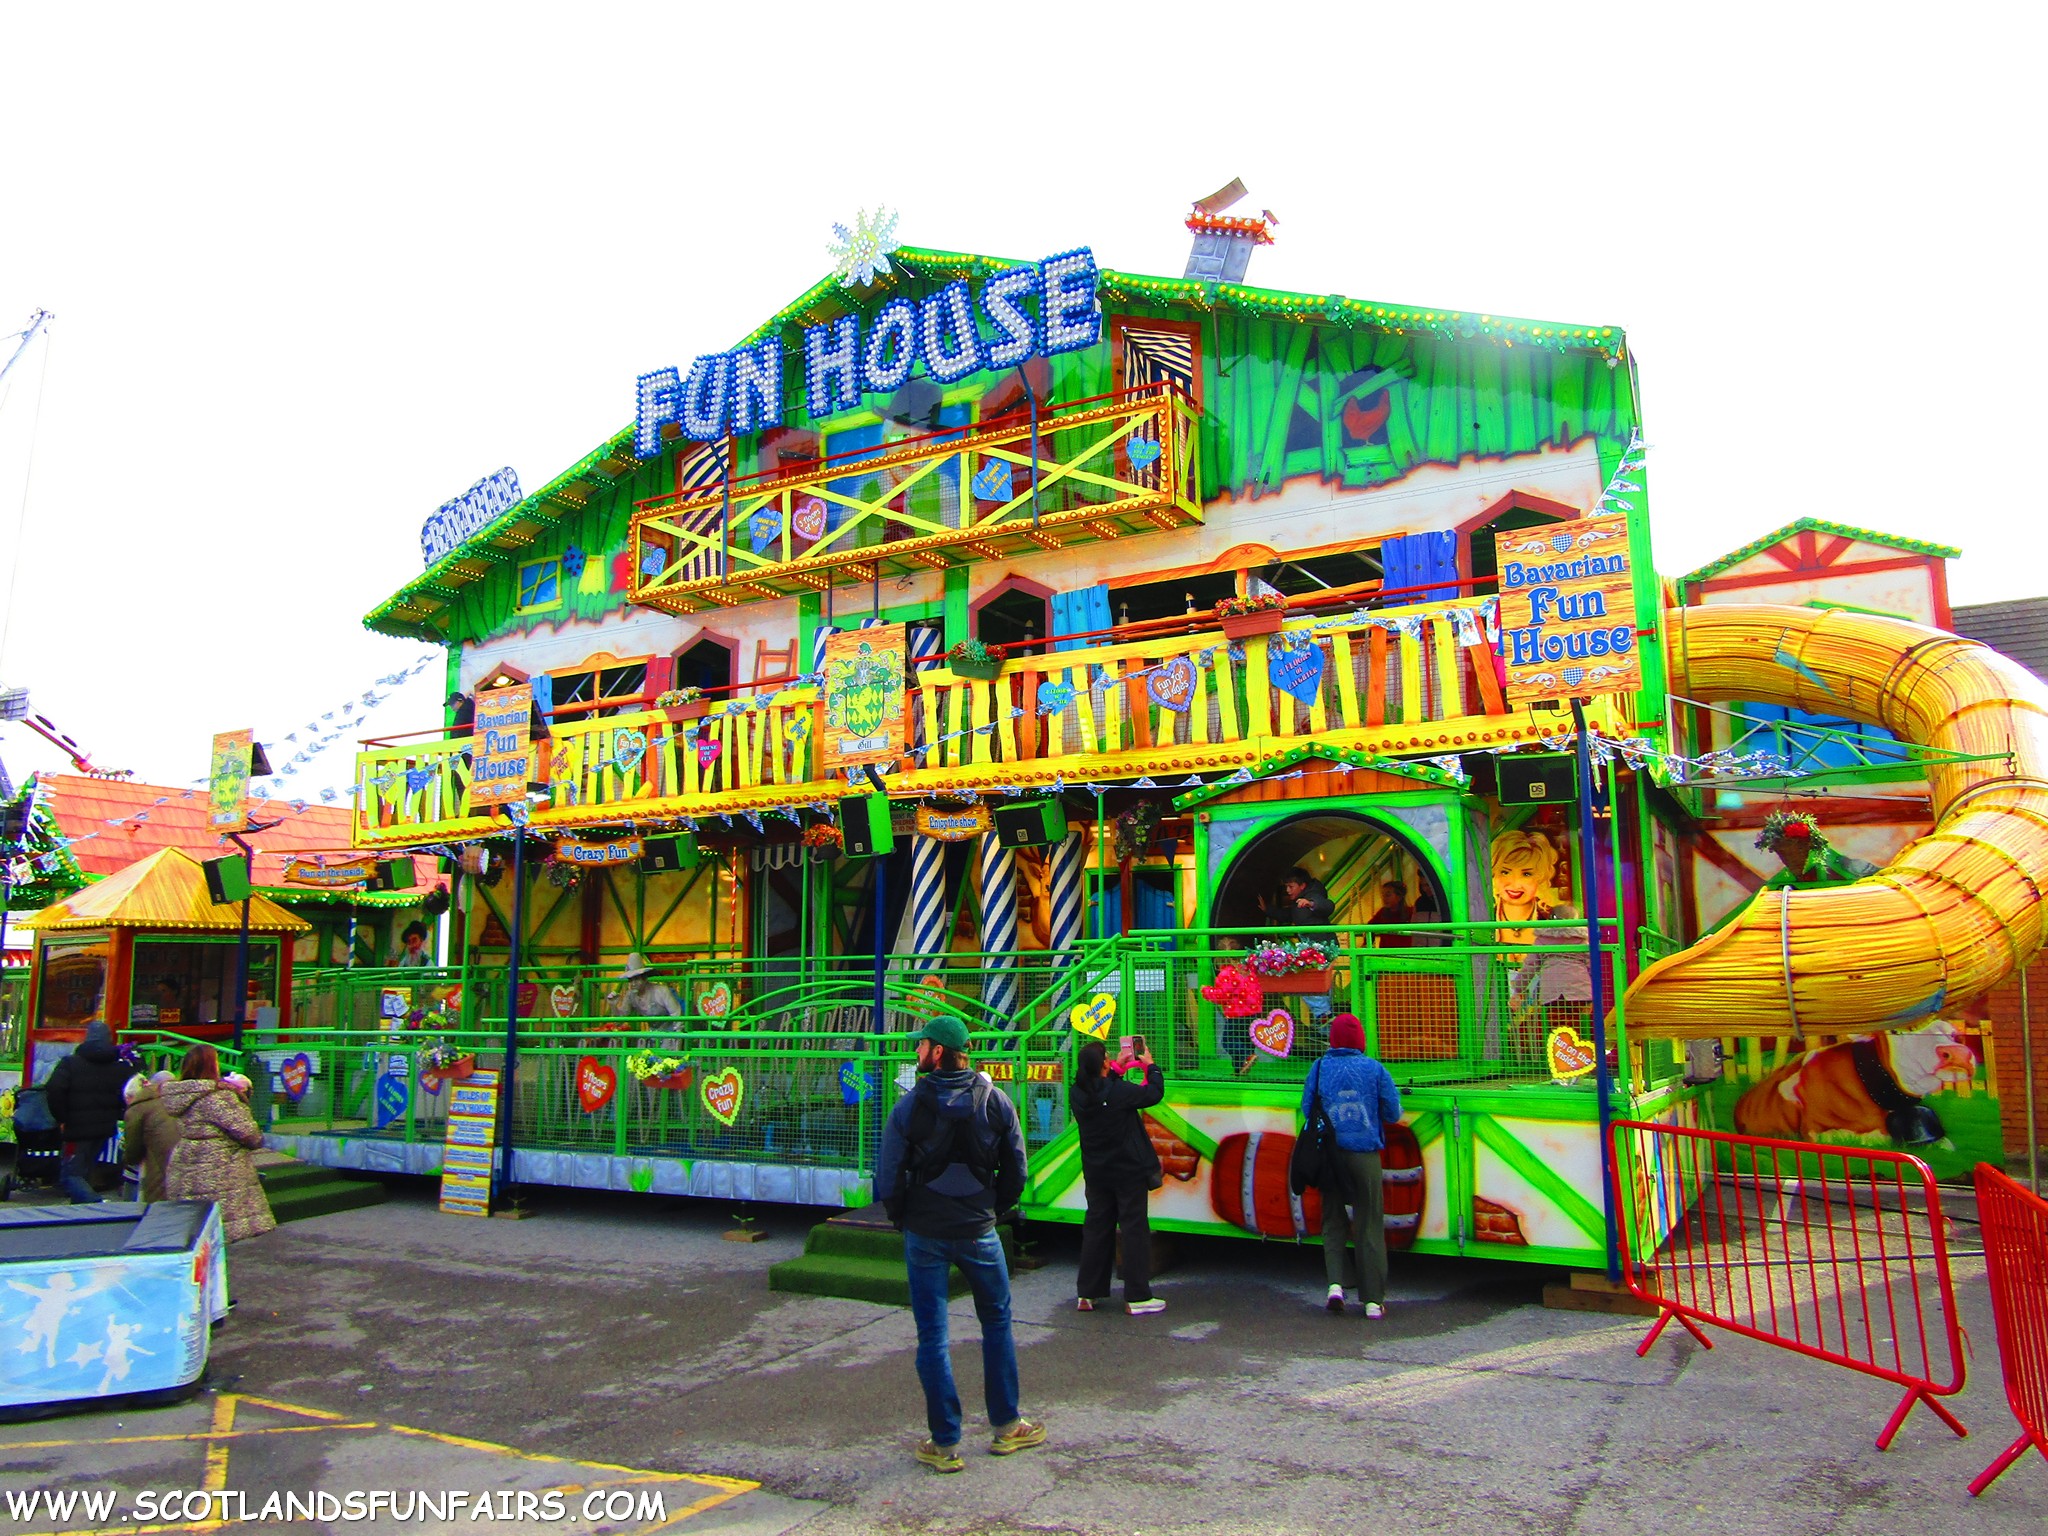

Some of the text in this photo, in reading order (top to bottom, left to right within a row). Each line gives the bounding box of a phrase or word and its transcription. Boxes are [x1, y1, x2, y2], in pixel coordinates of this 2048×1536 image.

[634, 246, 1102, 459] FUN HOUSE
[428, 469, 516, 557] BAVARIAN
[757, 517, 778, 527] HOUSE
[798, 509, 821, 528] 3 floors
[804, 517, 822, 533] of fun
[1504, 554, 1625, 588] Bavarian
[1527, 587, 1607, 625] Fun
[1508, 627, 1632, 665] House
[1156, 678, 1171, 692] Fun
[1287, 667, 1318, 691] LAUGHTER
[1162, 680, 1190, 700] all ages
[477, 710, 528, 729] Bavarian
[484, 730, 517, 755] Fun
[858, 740, 872, 749] Gill
[473, 757, 526, 782] House
[929, 815, 977, 829] Enjoy the show
[573, 843, 628, 863] Crazy Fun
[299, 868, 314, 878] Fun
[327, 868, 339, 877] the
[341, 867, 364, 876] inside
[1258, 1021, 1285, 1039] 3 floors
[1266, 1031, 1287, 1046] of fun
[1555, 1049, 1577, 1068] inside
[1567, 1046, 1577, 1056] on
[1577, 1052, 1592, 1065] the
[583, 1069, 608, 1091] 3 floors
[582, 1083, 601, 1099] of fun
[707, 1081, 735, 1100] Crazy
